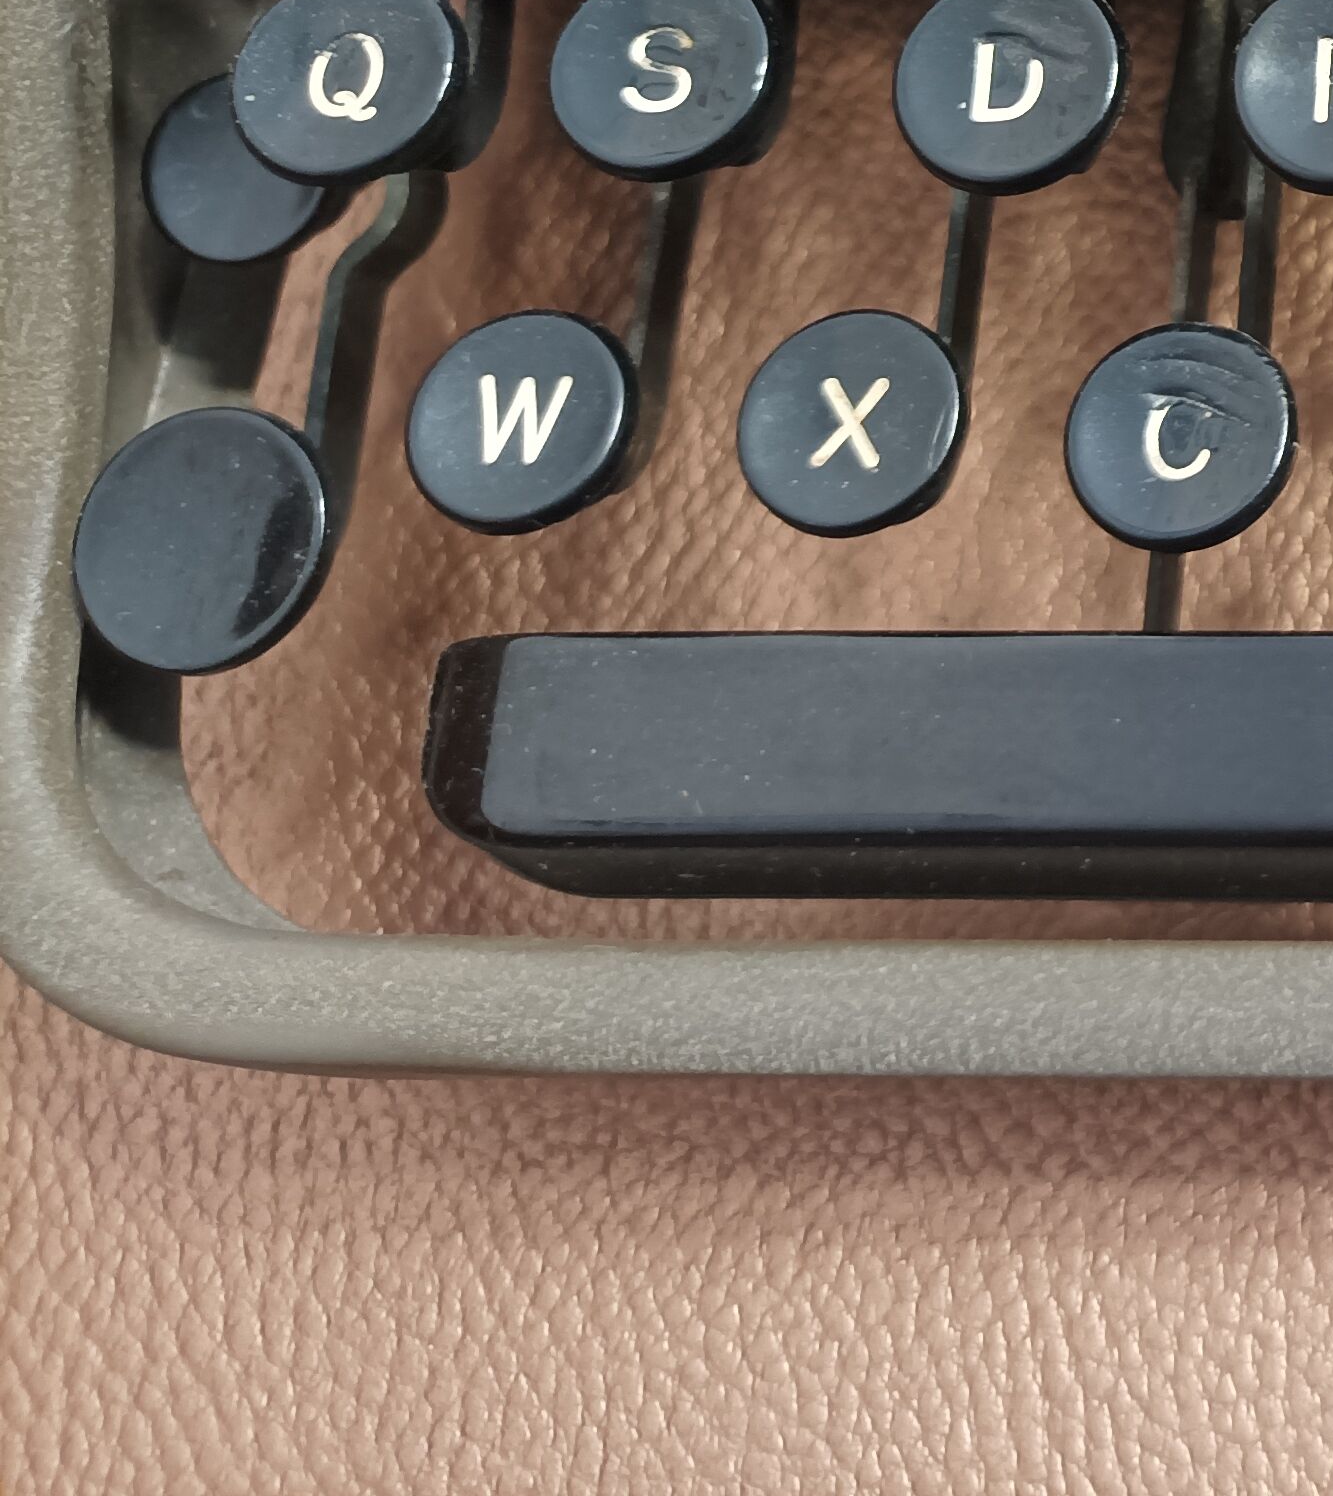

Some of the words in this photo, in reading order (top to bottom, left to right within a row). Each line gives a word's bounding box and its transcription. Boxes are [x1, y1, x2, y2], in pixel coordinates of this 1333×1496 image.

[306, 31, 385, 122] Q
[619, 25, 695, 114] S
[968, 32, 1045, 123] D
[477, 373, 574, 466] W
[807, 376, 891, 471] X
[1141, 392, 1212, 481] C
